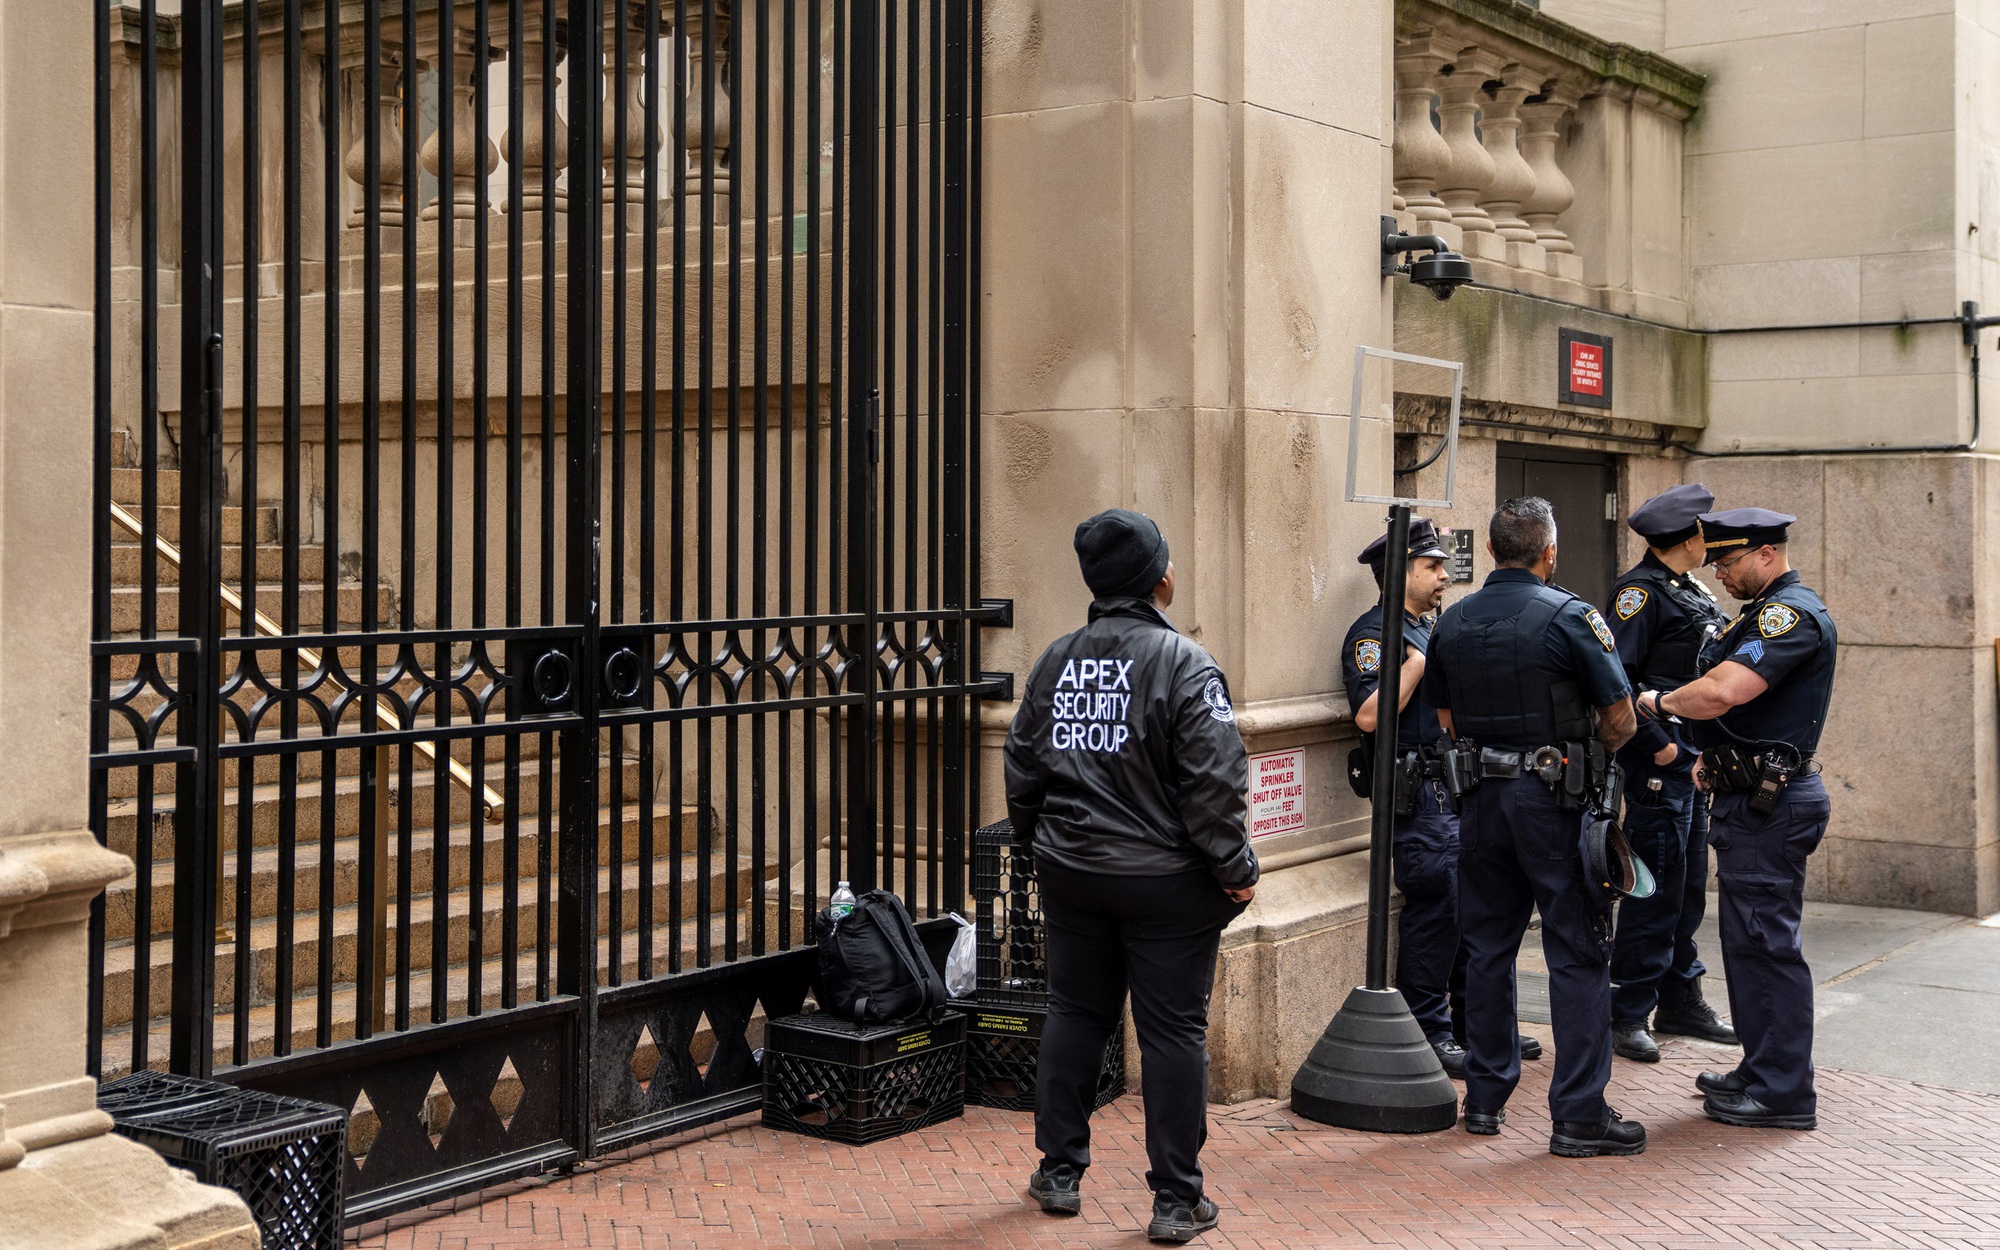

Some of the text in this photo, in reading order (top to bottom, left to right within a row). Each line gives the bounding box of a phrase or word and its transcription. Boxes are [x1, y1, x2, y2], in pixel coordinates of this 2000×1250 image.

[1586, 370, 1601, 379] ENTRANCE
[1056, 659, 1134, 690] APEX
[1052, 692, 1131, 721] SECURITY
[1052, 722, 1129, 752] GROUP
[1260, 757, 1294, 772] AUTOMATIC
[1261, 772, 1294, 787] SPRINKLER
[1253, 785, 1302, 804] SHUT OFF VALVE
[1282, 800, 1294, 812] FEET
[1254, 812, 1302, 832] OPPOSITE THIS SIGN
